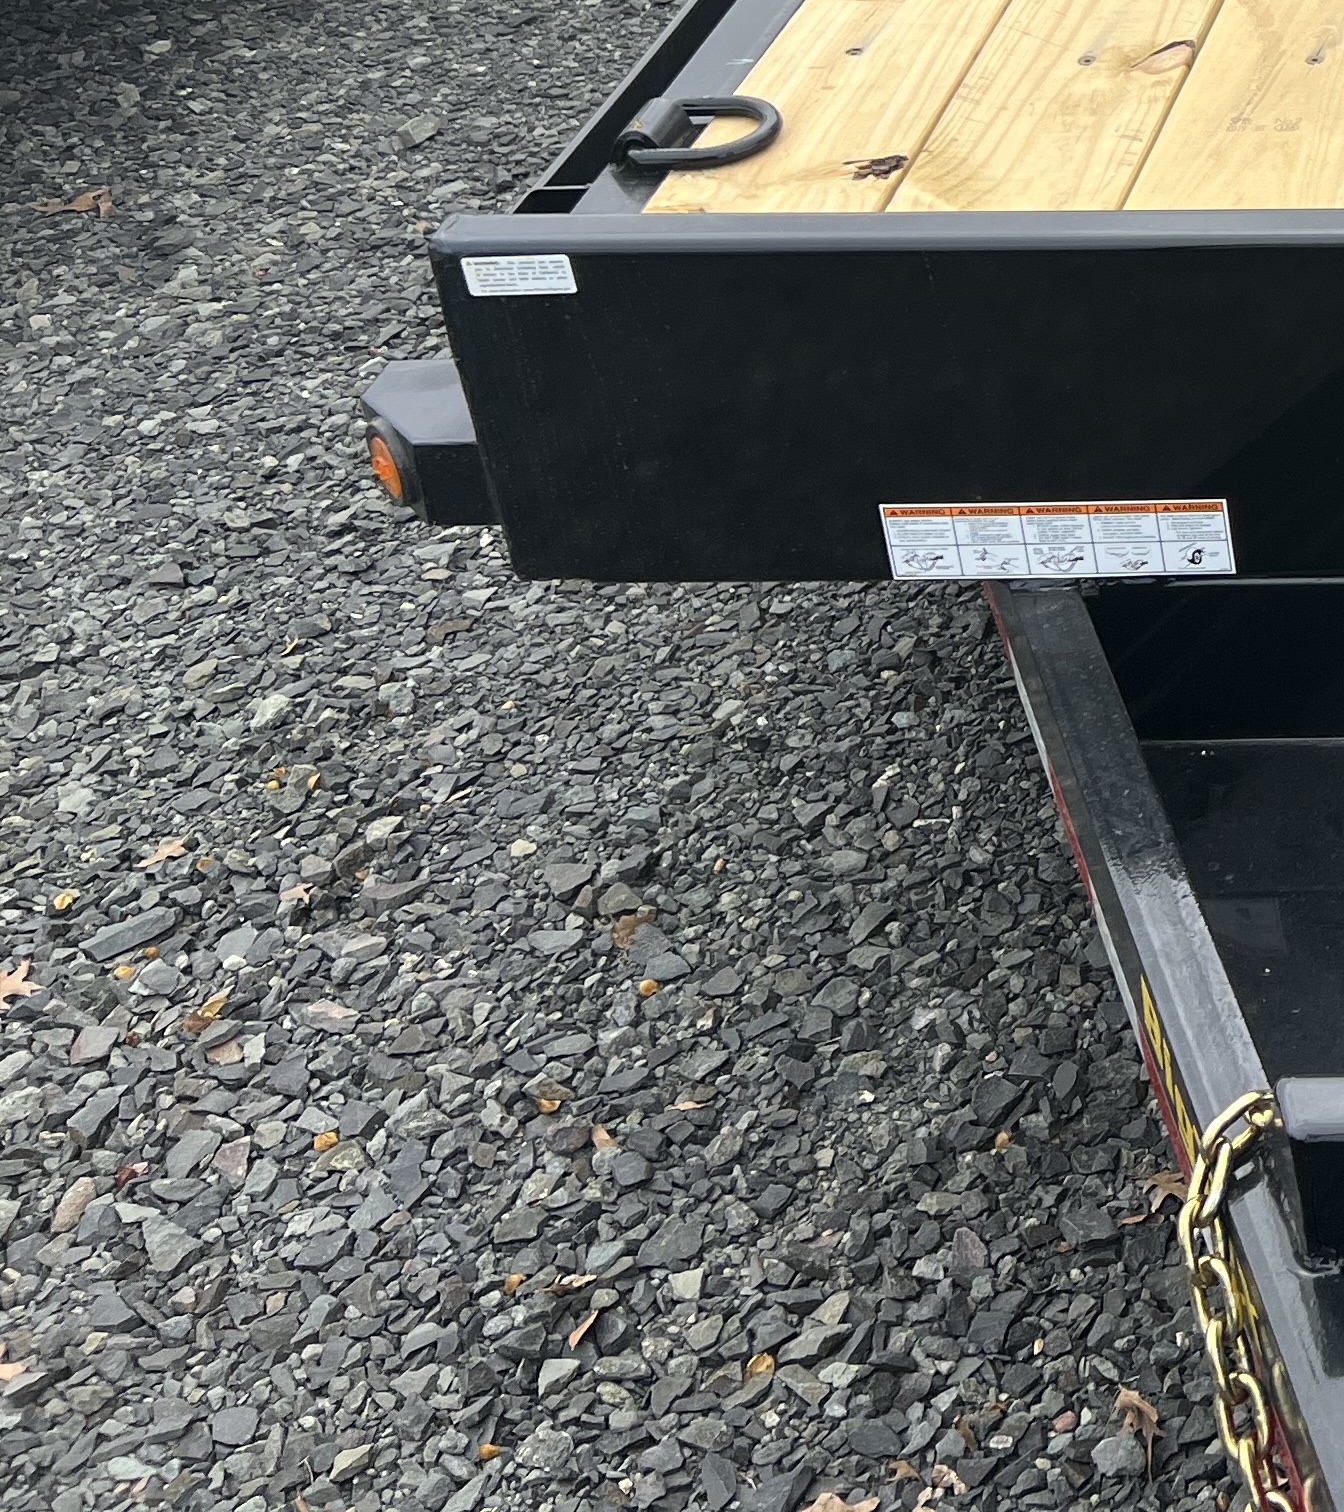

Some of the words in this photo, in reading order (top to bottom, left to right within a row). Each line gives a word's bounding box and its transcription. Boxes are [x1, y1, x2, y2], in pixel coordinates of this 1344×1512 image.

[900, 508, 945, 516] WARNING
[968, 507, 1014, 515] WARNING
[1036, 506, 1082, 514] WARNING
